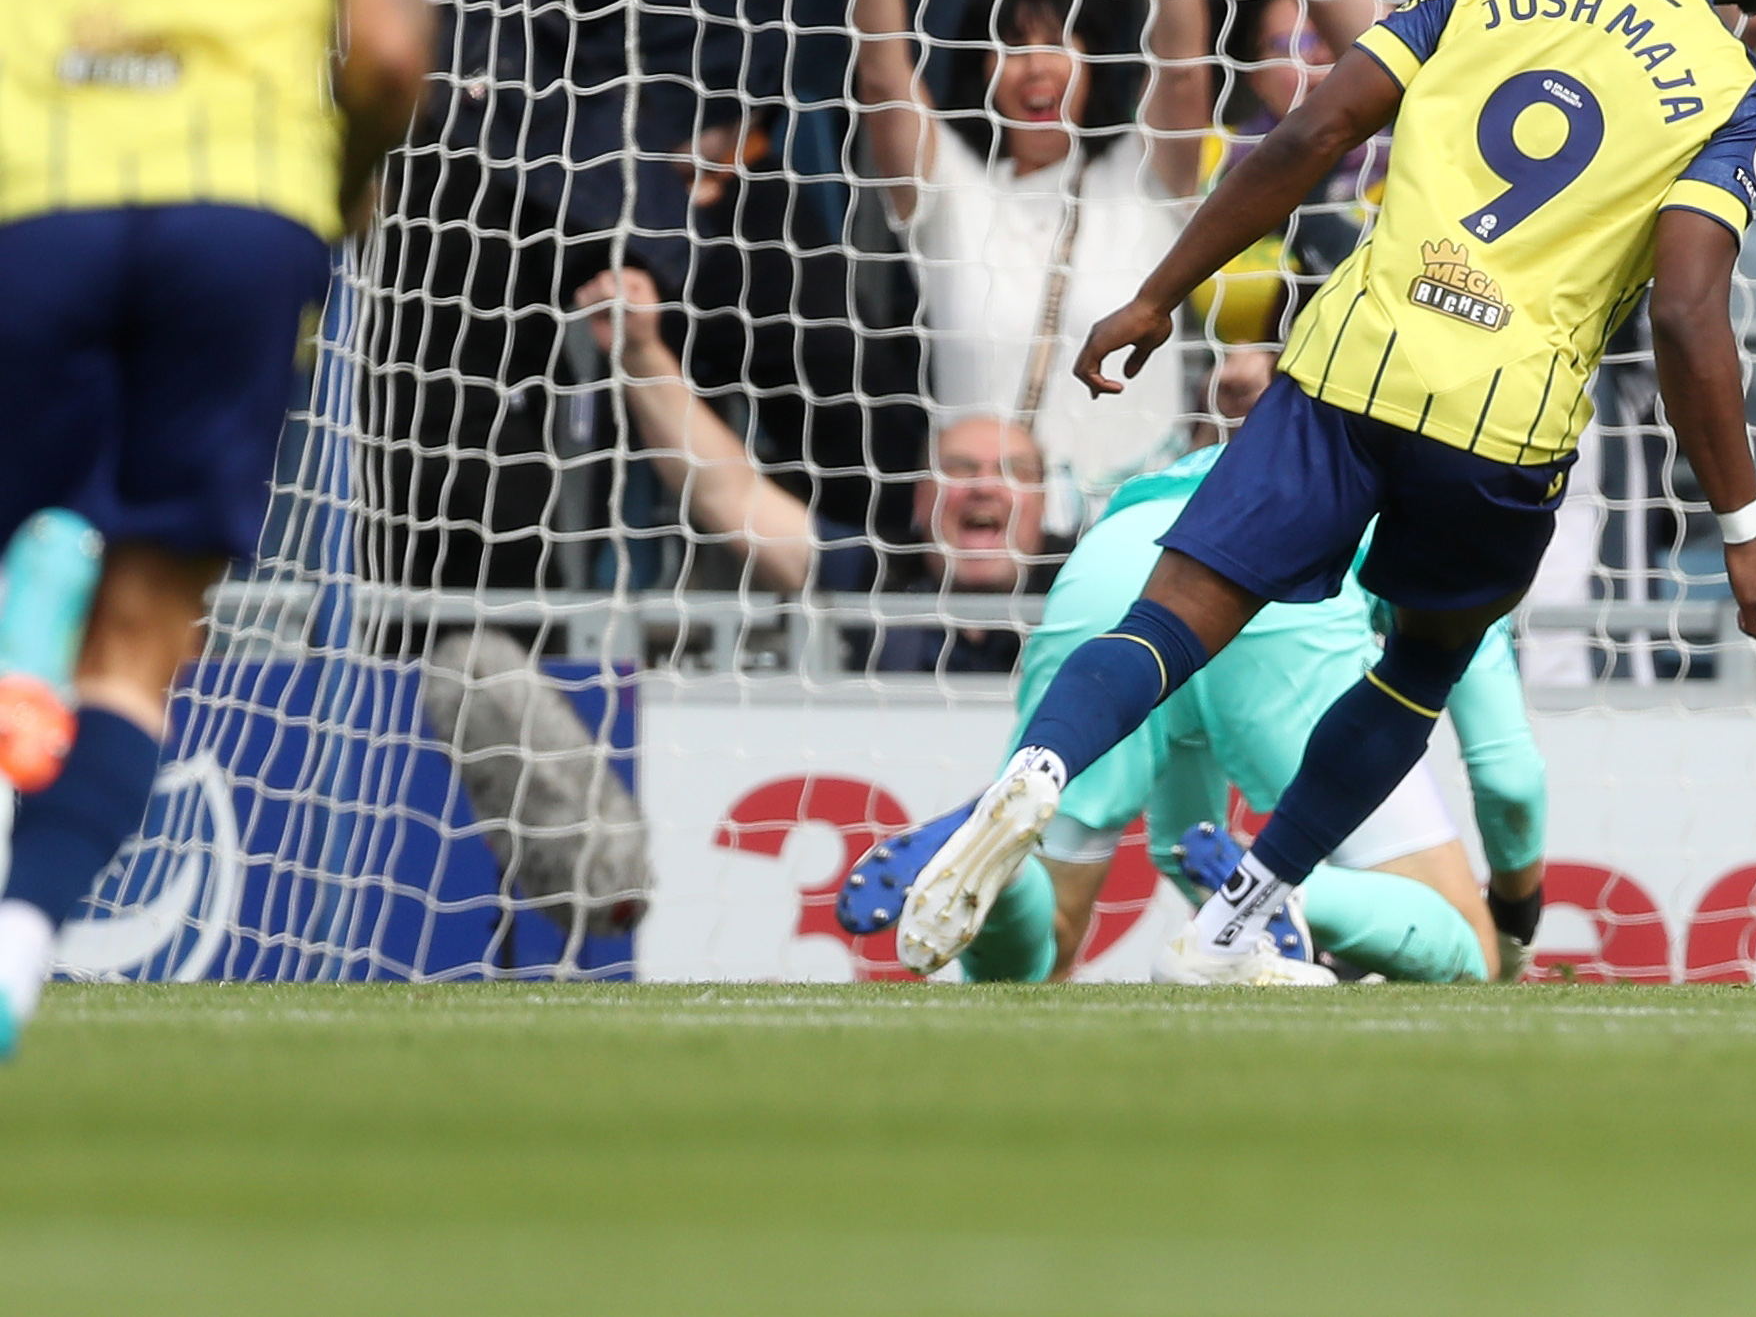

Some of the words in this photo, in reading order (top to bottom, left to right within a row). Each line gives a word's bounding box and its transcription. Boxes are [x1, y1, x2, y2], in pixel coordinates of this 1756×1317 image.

[1605, 4, 1704, 125] MAJA
[1459, 69, 1605, 244] 9
[1415, 282, 1499, 326] RICHES
[1424, 263, 1503, 305] MEGA
